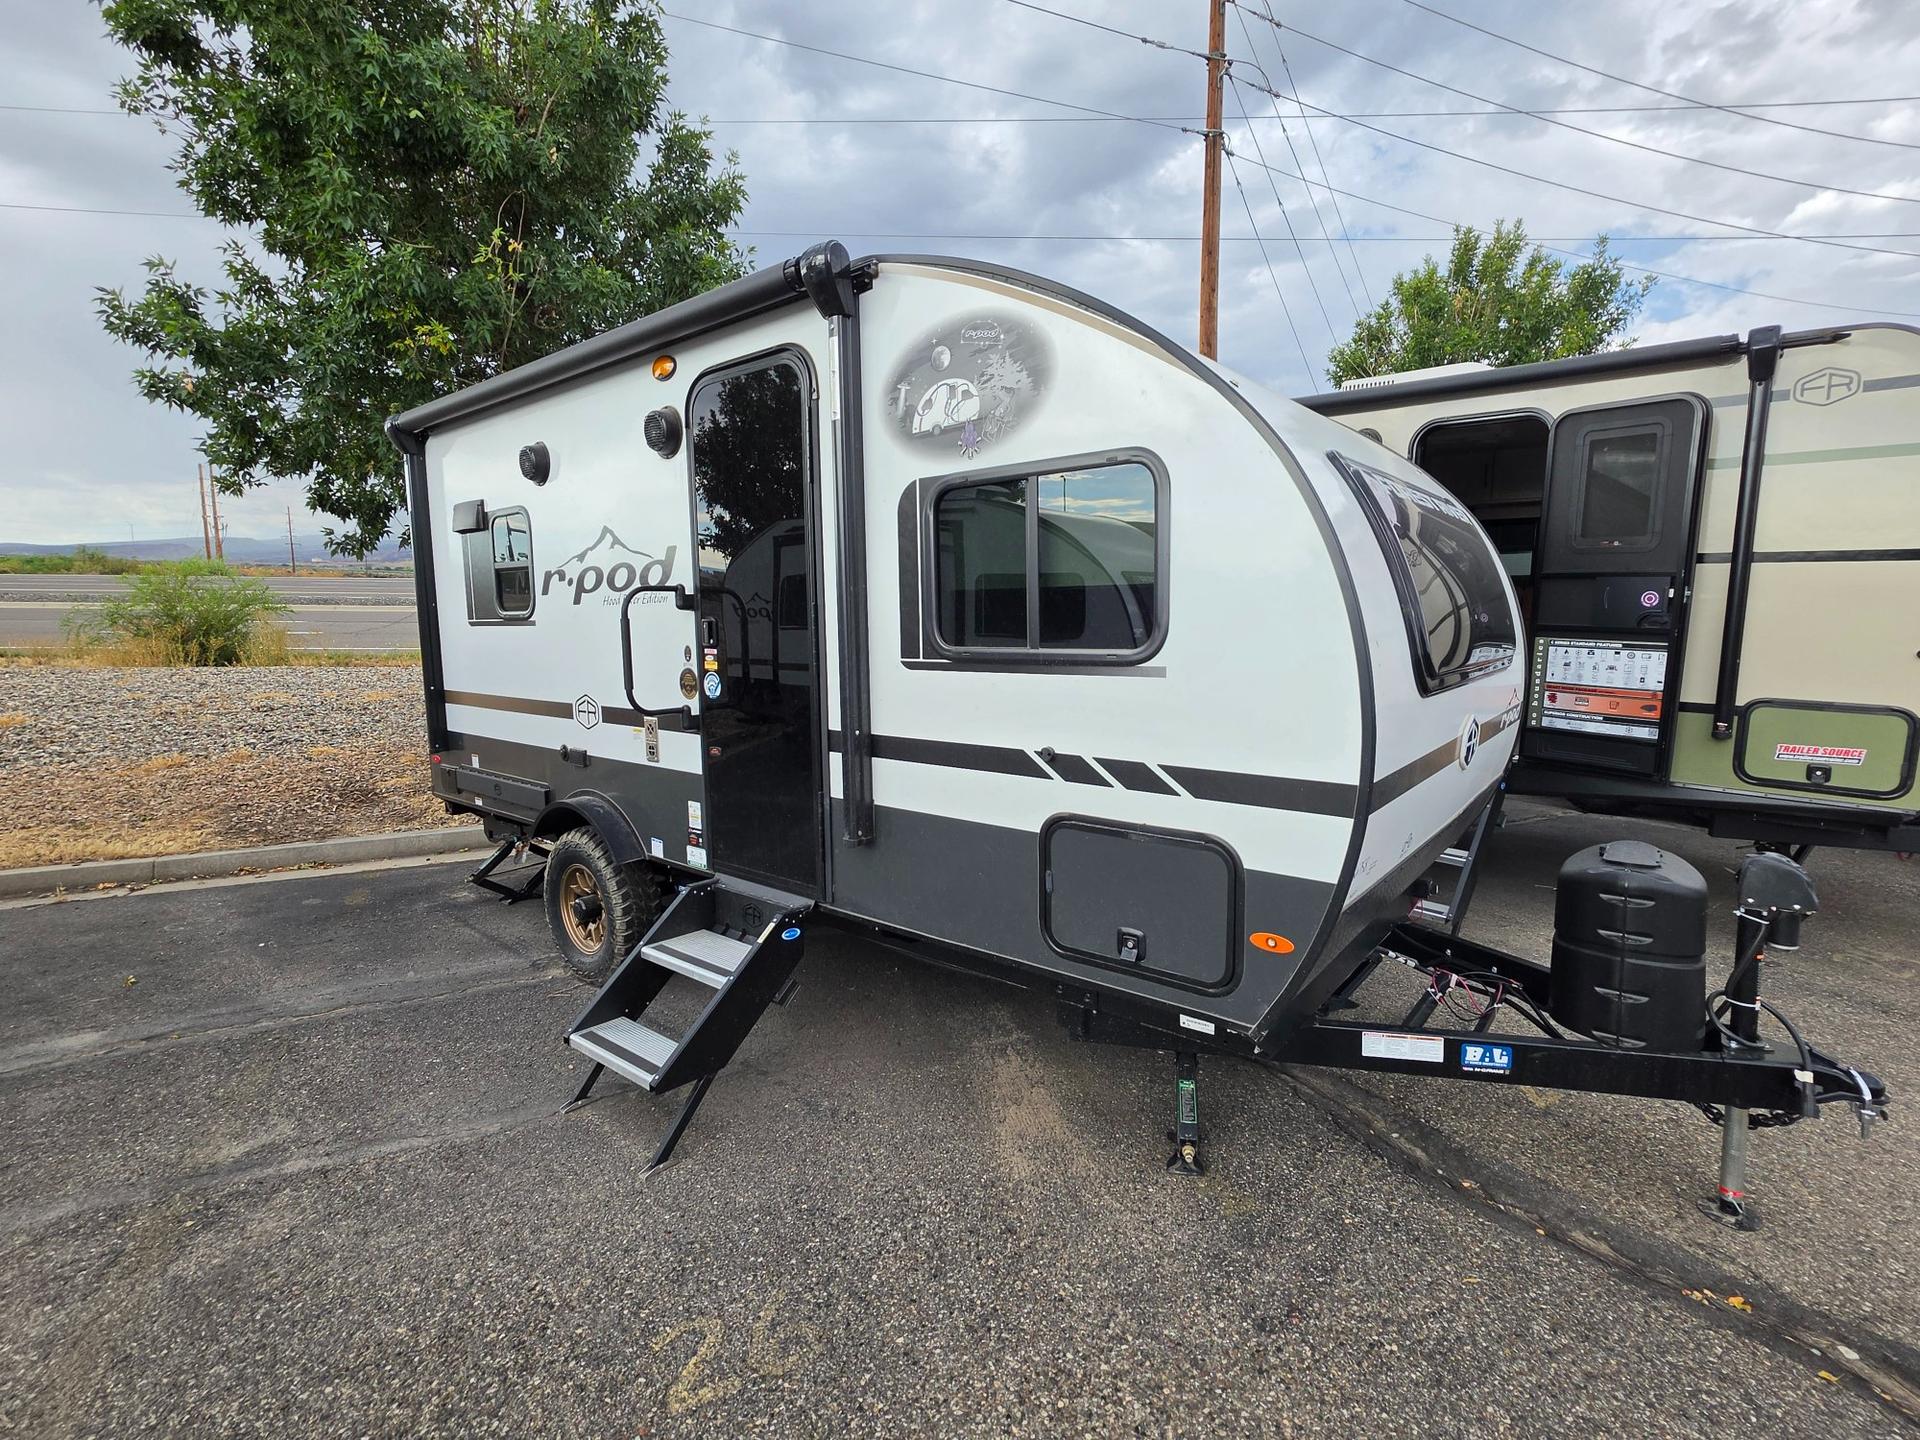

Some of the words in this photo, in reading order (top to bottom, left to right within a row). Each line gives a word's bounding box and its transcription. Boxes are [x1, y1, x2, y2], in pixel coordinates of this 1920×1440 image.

[603, 595, 621, 606] Hood
[641, 593, 669, 605] Edition
[1778, 745, 1820, 755] TRAILER
[1821, 748, 1865, 757] SOURCE
